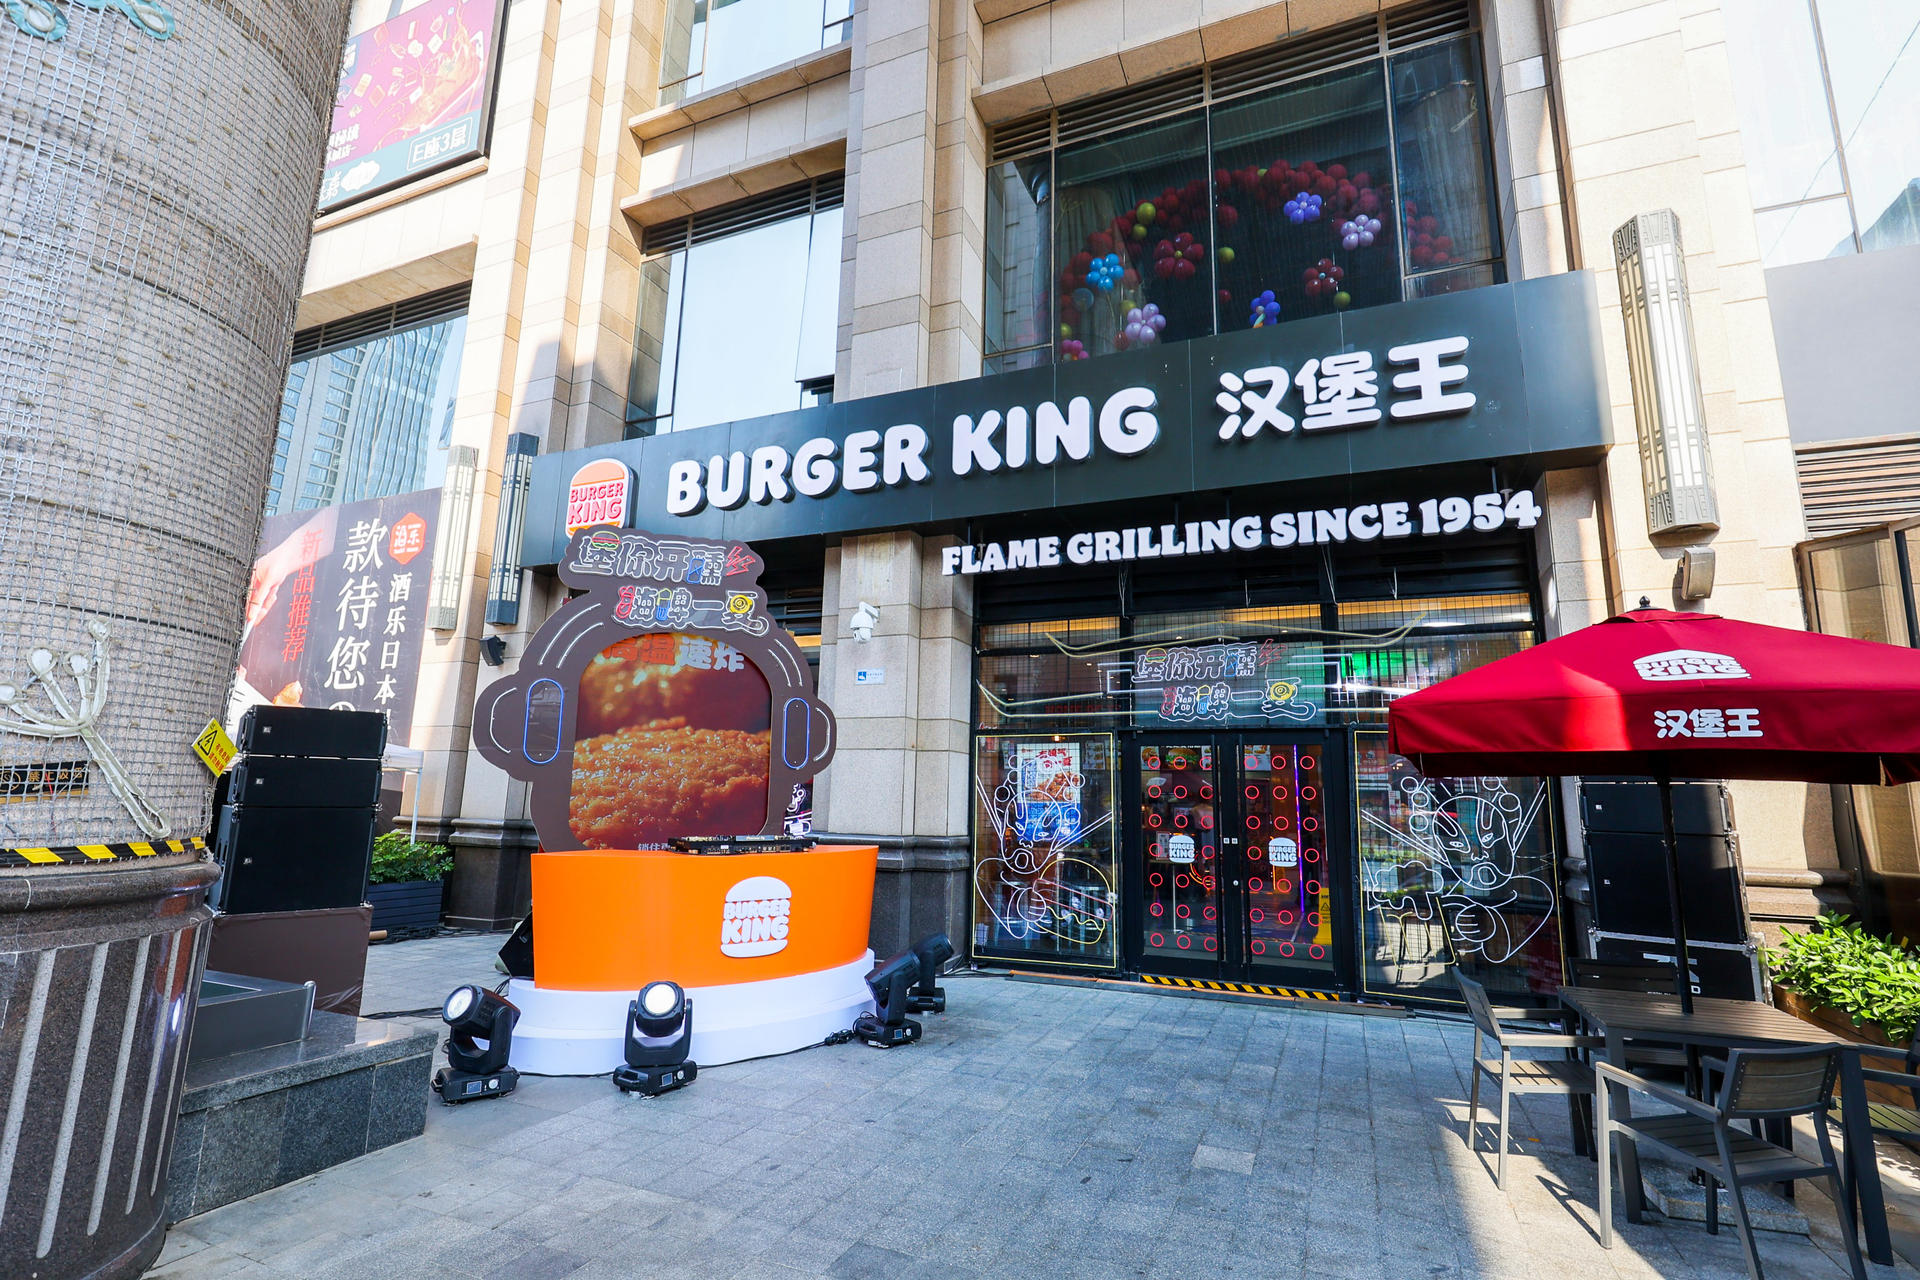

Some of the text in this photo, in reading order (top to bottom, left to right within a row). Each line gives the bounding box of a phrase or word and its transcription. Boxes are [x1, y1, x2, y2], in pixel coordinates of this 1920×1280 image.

[412, 124, 467, 163] E座3层
[1216, 336, 1477, 440] 汉堡王
[666, 387, 1160, 516] BURGER KING
[569, 482, 624, 504] BURGER
[567, 498, 622, 525] KING
[942, 490, 1542, 576] FLAME GRILLING SINCE 1954
[281, 529, 323, 663] 新品推荐
[1634, 658, 1742, 671] BURGER
[1638, 664, 1747, 677] KING
[1654, 708, 1764, 738] 汉堡王
[1169, 843, 1195, 851] BURGER
[1169, 849, 1195, 858] KING
[1268, 846, 1297, 854] BURGER
[1269, 852, 1298, 862] KING
[723, 899, 791, 920] BURGER
[721, 915, 790, 945] KING
